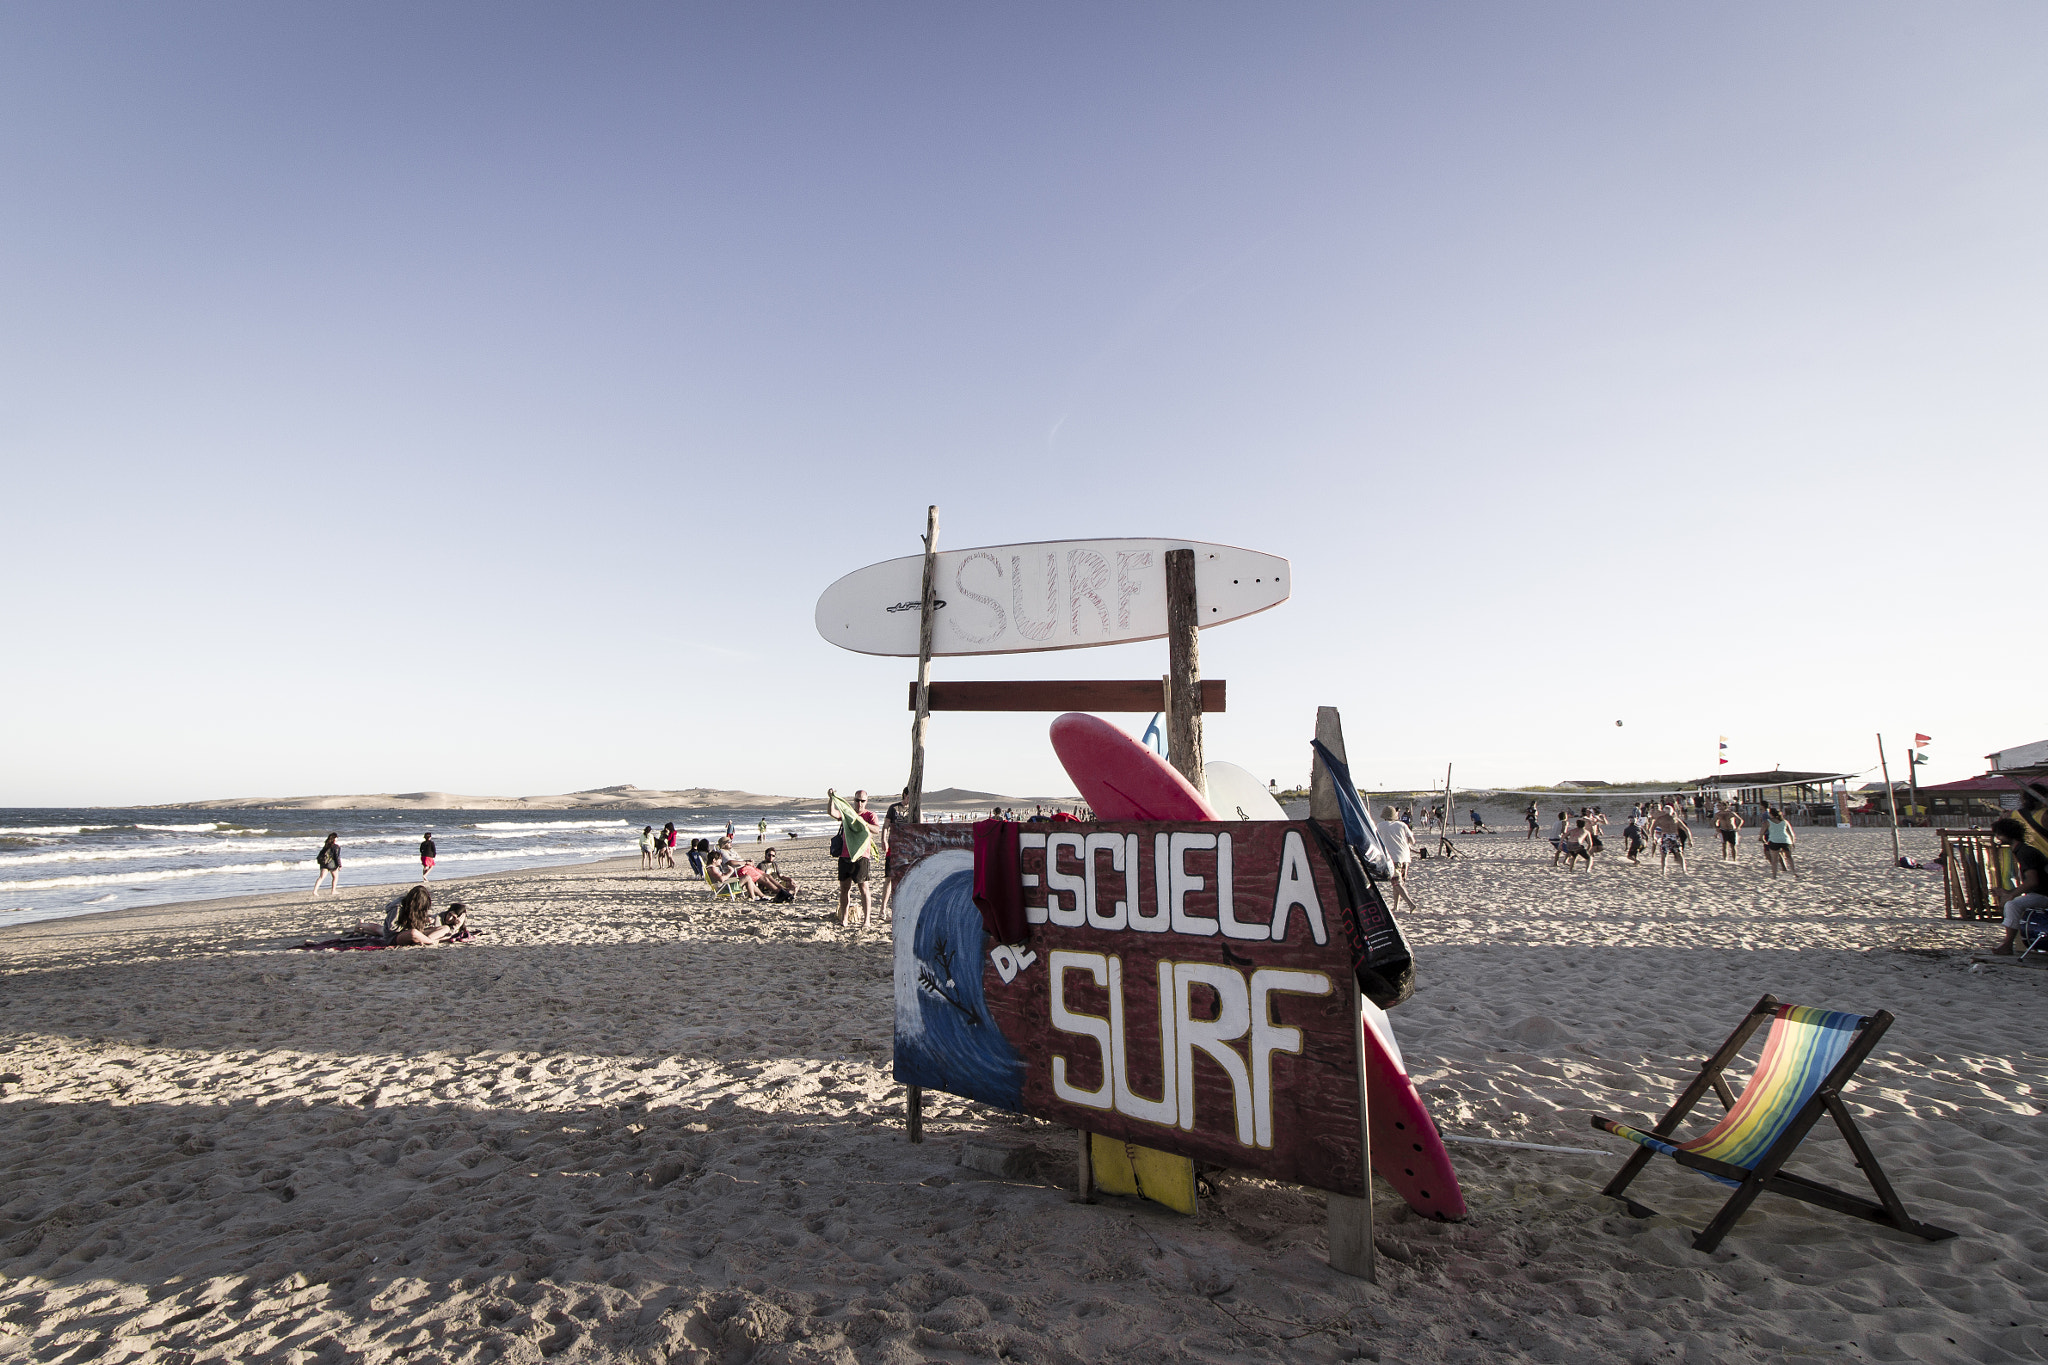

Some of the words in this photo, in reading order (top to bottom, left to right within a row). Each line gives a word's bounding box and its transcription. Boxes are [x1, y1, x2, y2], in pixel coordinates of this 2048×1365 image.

[950, 549, 1154, 643] SURF
[1019, 831, 1328, 946] ESCUELA
[990, 944, 1037, 984] DE
[1048, 949, 1334, 1150] SURF
